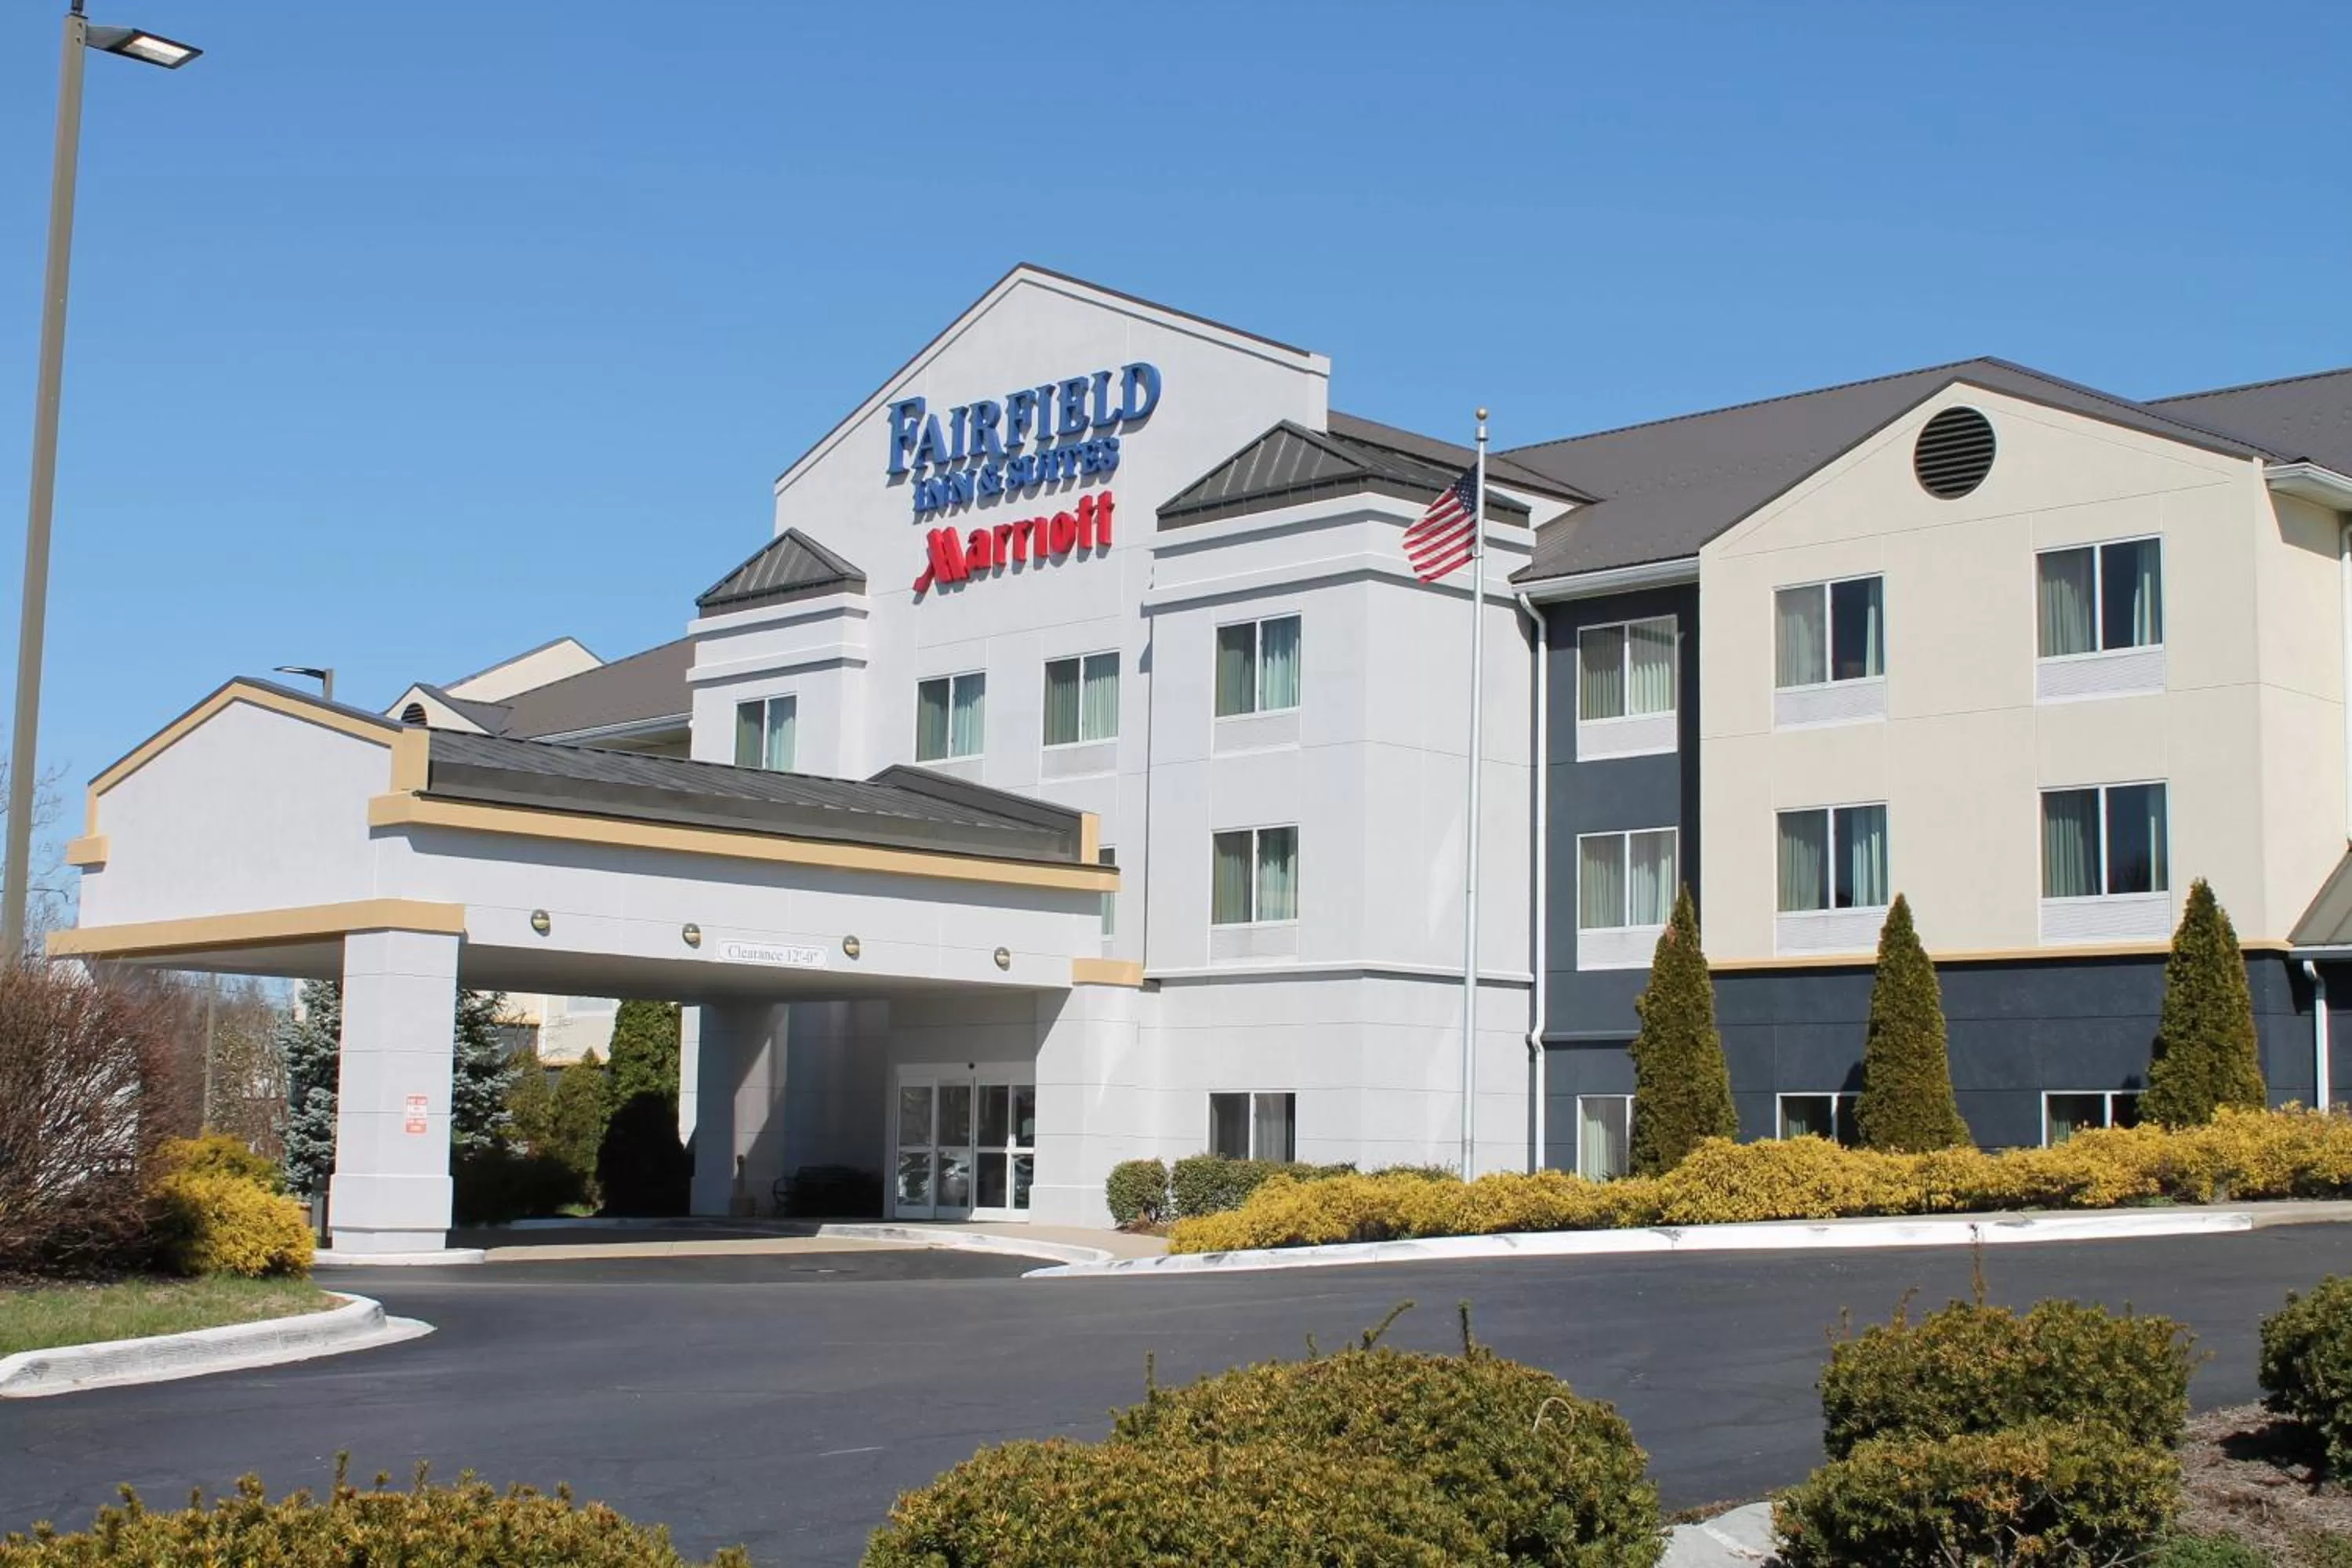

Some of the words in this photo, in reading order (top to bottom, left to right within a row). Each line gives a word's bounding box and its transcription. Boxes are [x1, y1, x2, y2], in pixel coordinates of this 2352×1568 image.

[886, 361, 1161, 475] FAIRFIELD
[913, 468, 975, 514] INN
[1005, 437, 1120, 490] SUITES
[912, 490, 1115, 593] Marriott
[728, 945, 782, 961] Clearance
